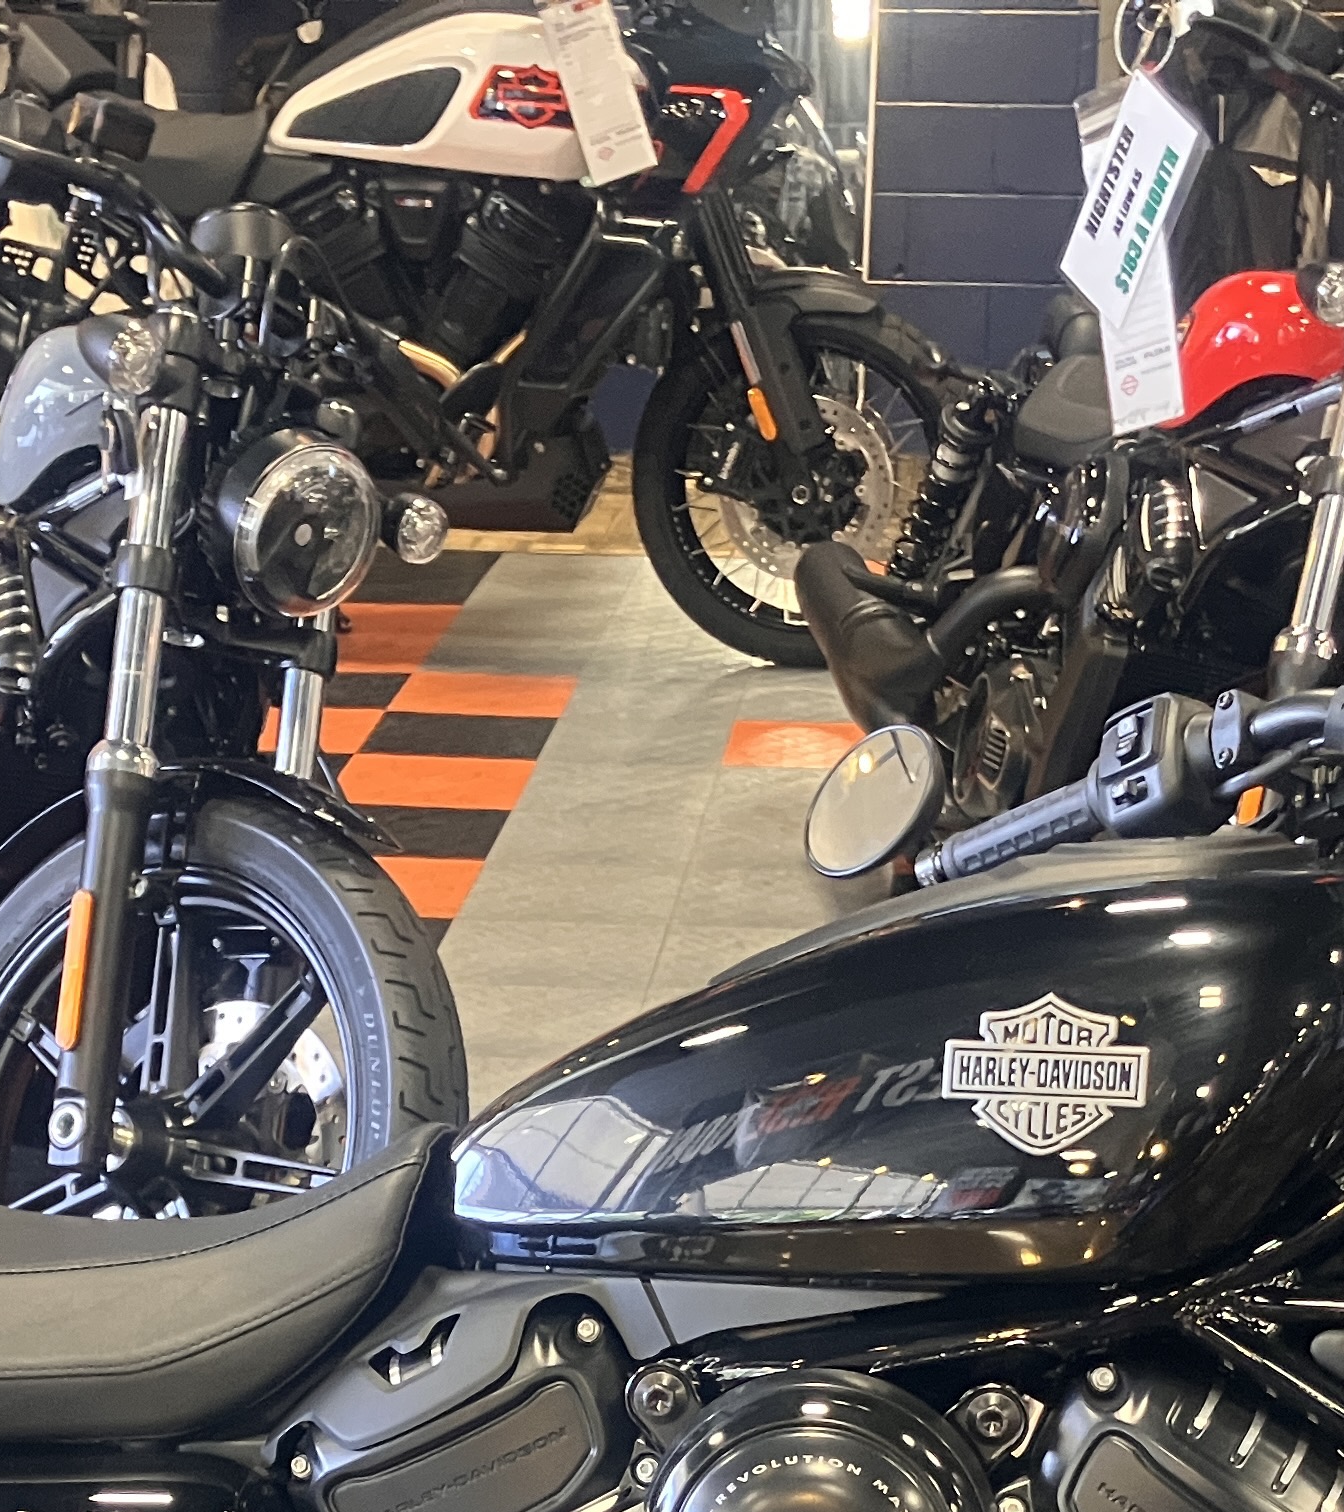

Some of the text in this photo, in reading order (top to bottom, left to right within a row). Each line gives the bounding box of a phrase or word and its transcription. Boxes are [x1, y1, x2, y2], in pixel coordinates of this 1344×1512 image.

[1083, 124, 1135, 241] NIGHTSTER
[1118, 188, 1136, 219] LOW
[1130, 166, 1144, 187] AS
[1139, 143, 1180, 227] MONTH
[1132, 222, 1151, 245] A
[1002, 1011, 1094, 1049] MOTOR
[958, 1055, 1134, 1093] HARLEY-DAVIDSON
[995, 1099, 1090, 1141] CYCLES
[713, 1453, 863, 1506] REVOLUTION
